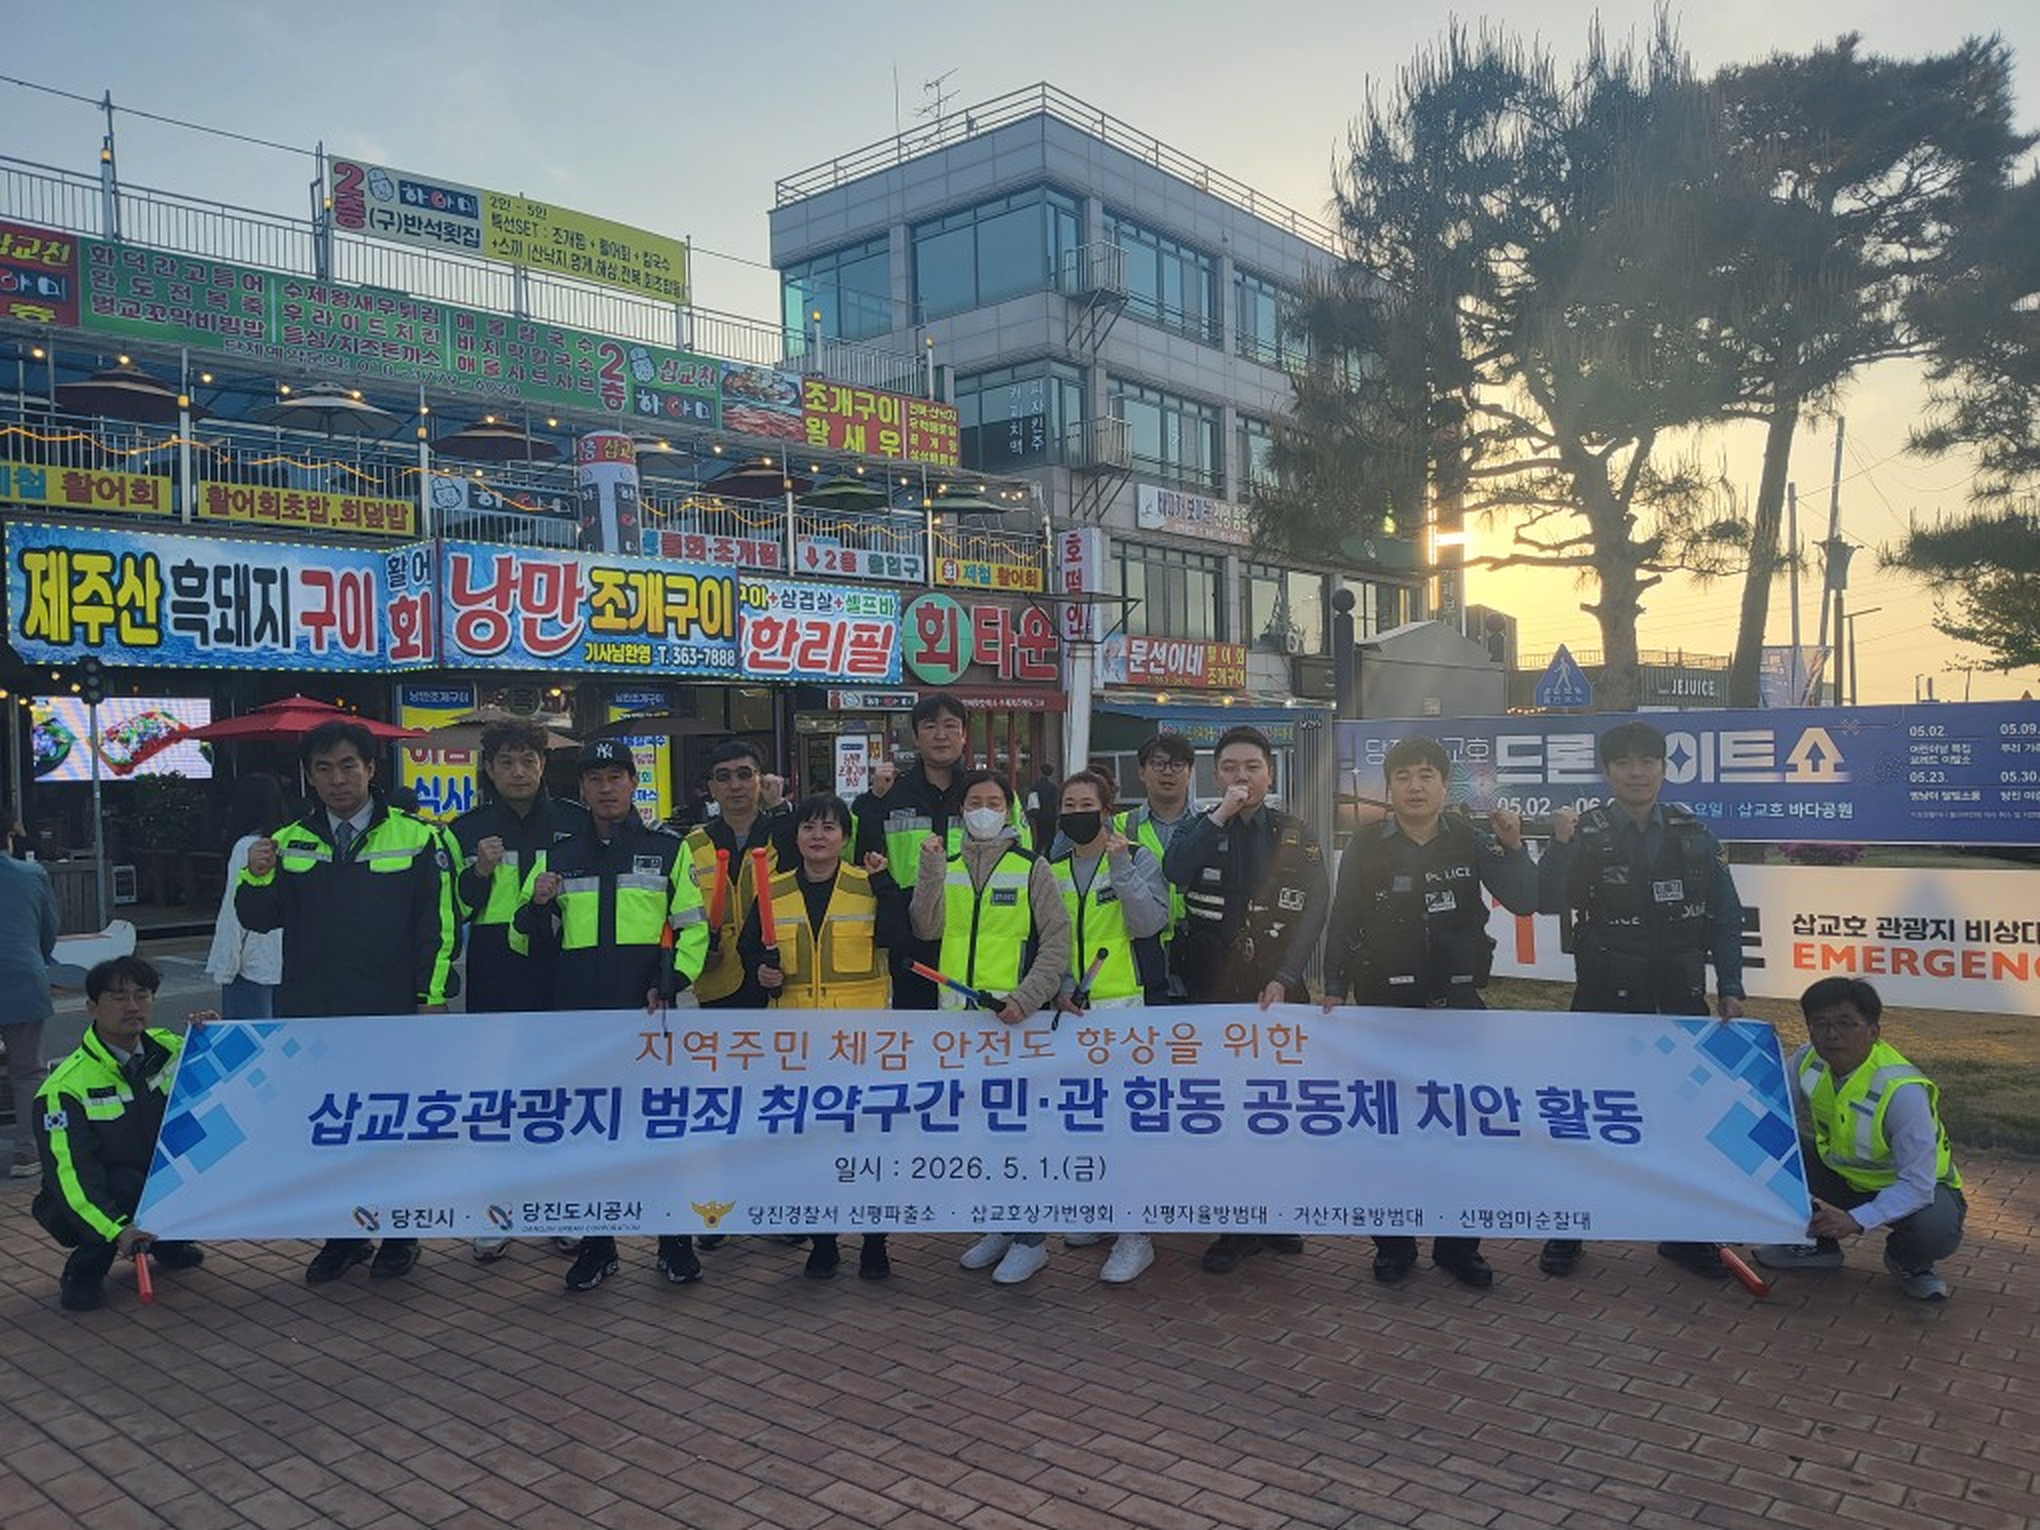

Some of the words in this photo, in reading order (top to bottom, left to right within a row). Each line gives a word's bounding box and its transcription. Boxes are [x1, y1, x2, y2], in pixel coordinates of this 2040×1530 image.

[370, 207, 480, 249] (구)반석횟집
[599, 342, 627, 412] 2층
[805, 381, 900, 426] 조개구이
[62, 472, 159, 510] 활어회
[387, 548, 432, 591] 활어
[963, 564, 992, 584] 제철
[21, 546, 163, 646] 제주산
[170, 559, 292, 648] 흑돼지
[301, 568, 376, 652] 구이
[451, 553, 586, 653] 낭만
[590, 567, 737, 639] 조개구이
[388, 592, 432, 661] 회
[1129, 640, 1204, 677] 문선이네
[1672, 679, 1715, 697] JEJUICE
[415, 775, 475, 814] 식사
[1737, 803, 1785, 818] 삽교호
[1788, 802, 1853, 819] 바다공원
[1792, 913, 1869, 939] 삽교호
[1877, 916, 1956, 943] 관광지
[636, 1029, 810, 1071] 지역주민
[829, 1029, 915, 1071] 체감
[932, 1029, 1056, 1069] 안전도
[1076, 1022, 1203, 1065] 향상을
[1224, 1022, 1309, 1065] 위한
[308, 1086, 622, 1146] 삽교호관광지
[641, 1085, 743, 1139] 범죄
[757, 1079, 966, 1134] 취약구간
[981, 1077, 1109, 1132] 민·관
[1124, 1076, 1226, 1135] 합동
[1243, 1079, 1399, 1136] 공동체
[1416, 1080, 1522, 1137] 치안
[1535, 1085, 1643, 1145] 활동
[835, 1156, 882, 1182] 일시
[911, 1157, 992, 1181] 2026.
[391, 1208, 455, 1229] 당진시
[522, 1201, 643, 1221] 당진도시공사
[748, 1205, 839, 1226] 당진경찰서
[848, 1204, 937, 1226] 신평파출소
[970, 1204, 1115, 1226] 삽교호상가번영회
[1141, 1204, 1269, 1226] 신평자율방범대
[1293, 1206, 1425, 1229] 거산자율방범대
[1459, 1209, 1592, 1231] 신평엄마순찰대
